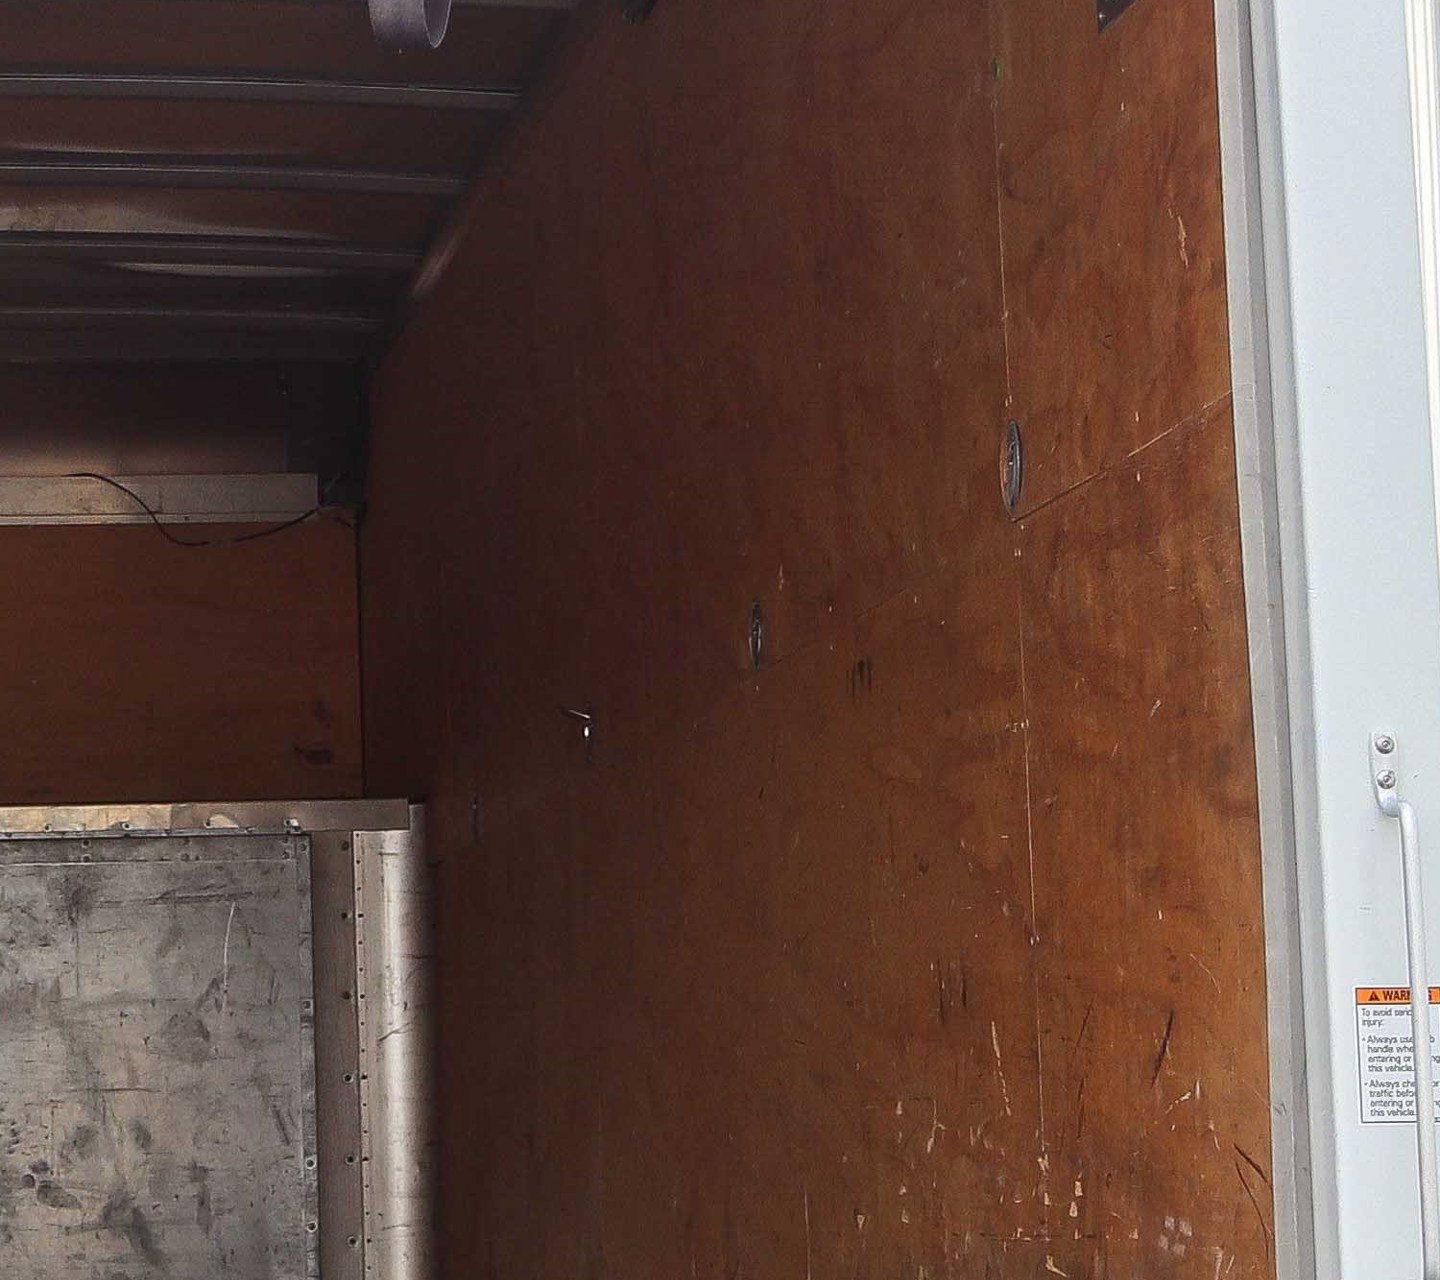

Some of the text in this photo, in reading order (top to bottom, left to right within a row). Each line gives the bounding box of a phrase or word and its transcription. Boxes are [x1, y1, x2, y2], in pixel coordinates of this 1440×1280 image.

[1366, 1035, 1398, 1044] Always
[1367, 1045, 1394, 1053] handle
[1367, 1055, 1401, 1065] entering
[1367, 1064, 1383, 1072] this
[1368, 1079, 1400, 1089] Always
[1368, 1088, 1394, 1097] traffic
[1370, 1099, 1403, 1109] entering
[1370, 1108, 1385, 1116] this
